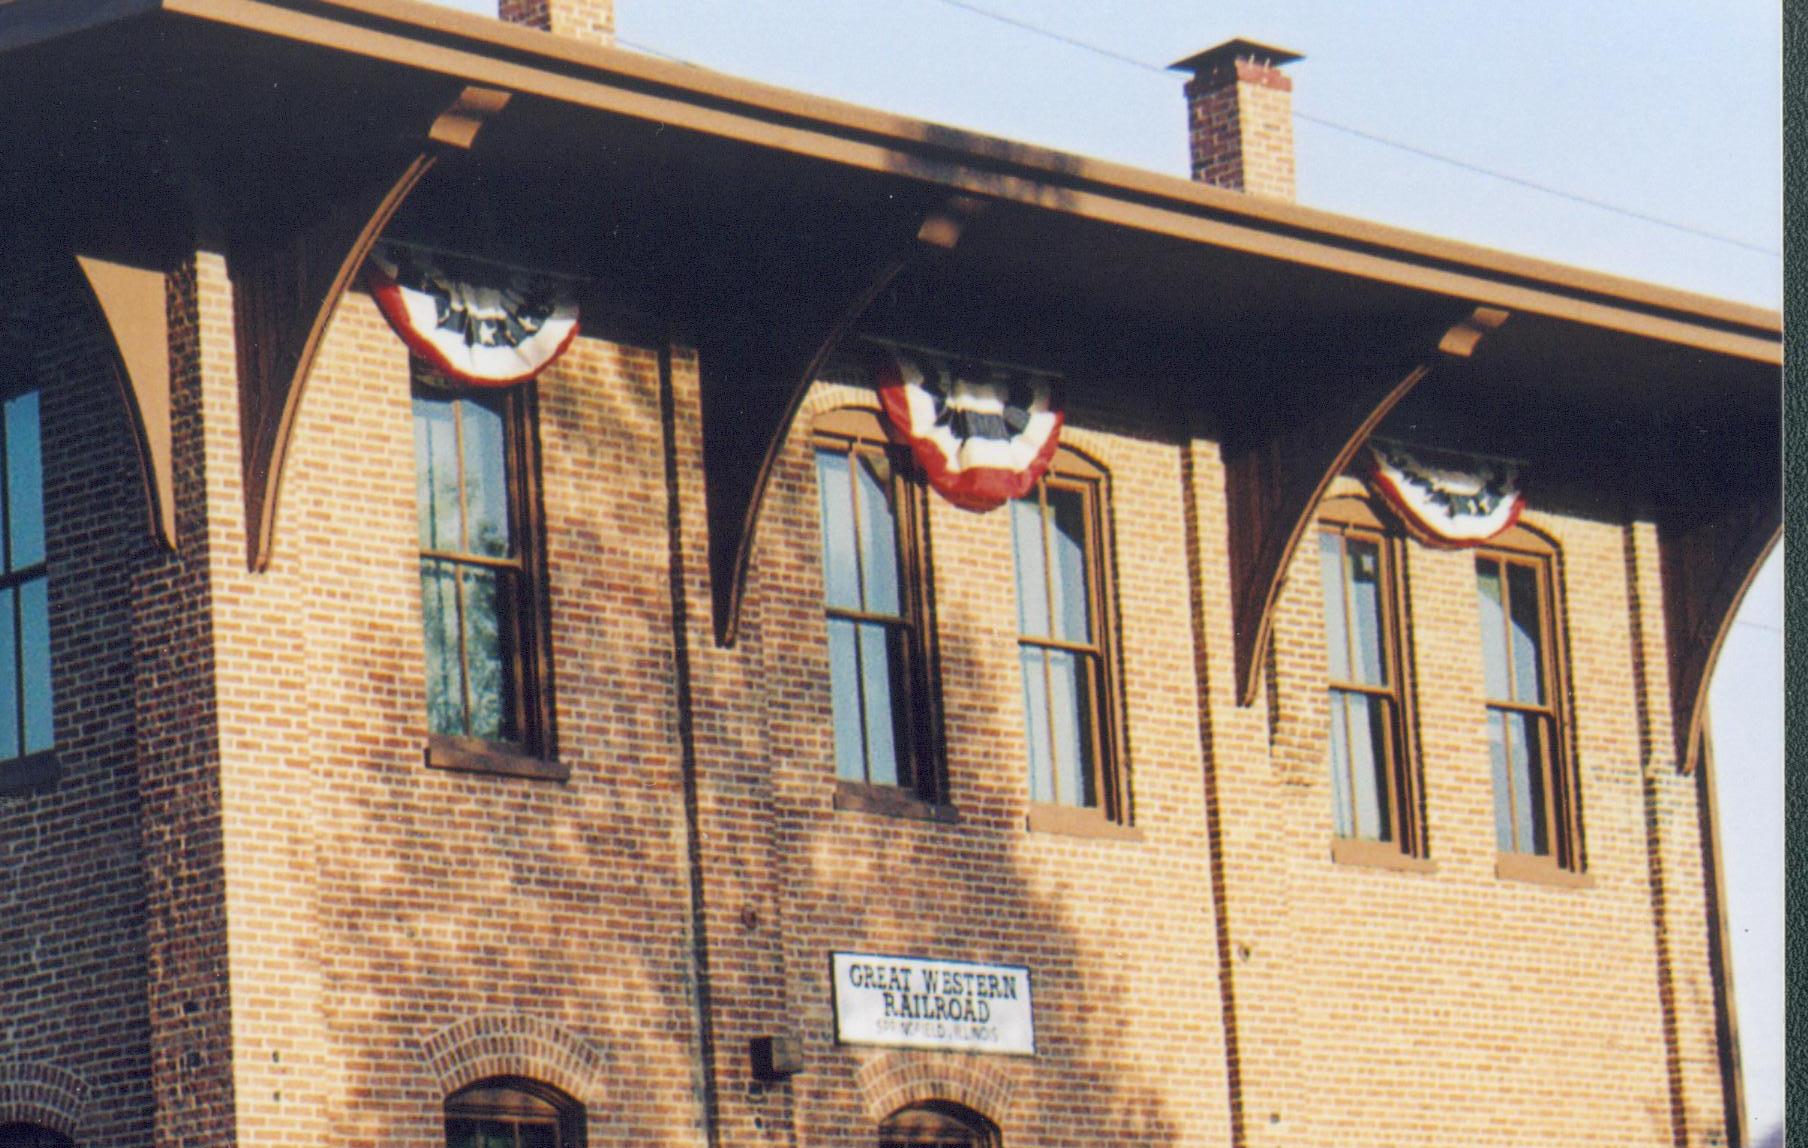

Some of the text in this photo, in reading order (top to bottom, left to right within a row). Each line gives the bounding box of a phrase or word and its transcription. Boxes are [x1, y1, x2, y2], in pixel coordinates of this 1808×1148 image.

[848, 963, 1018, 1000] GREAT WESTERN
[882, 992, 991, 1024] RAILROAD
